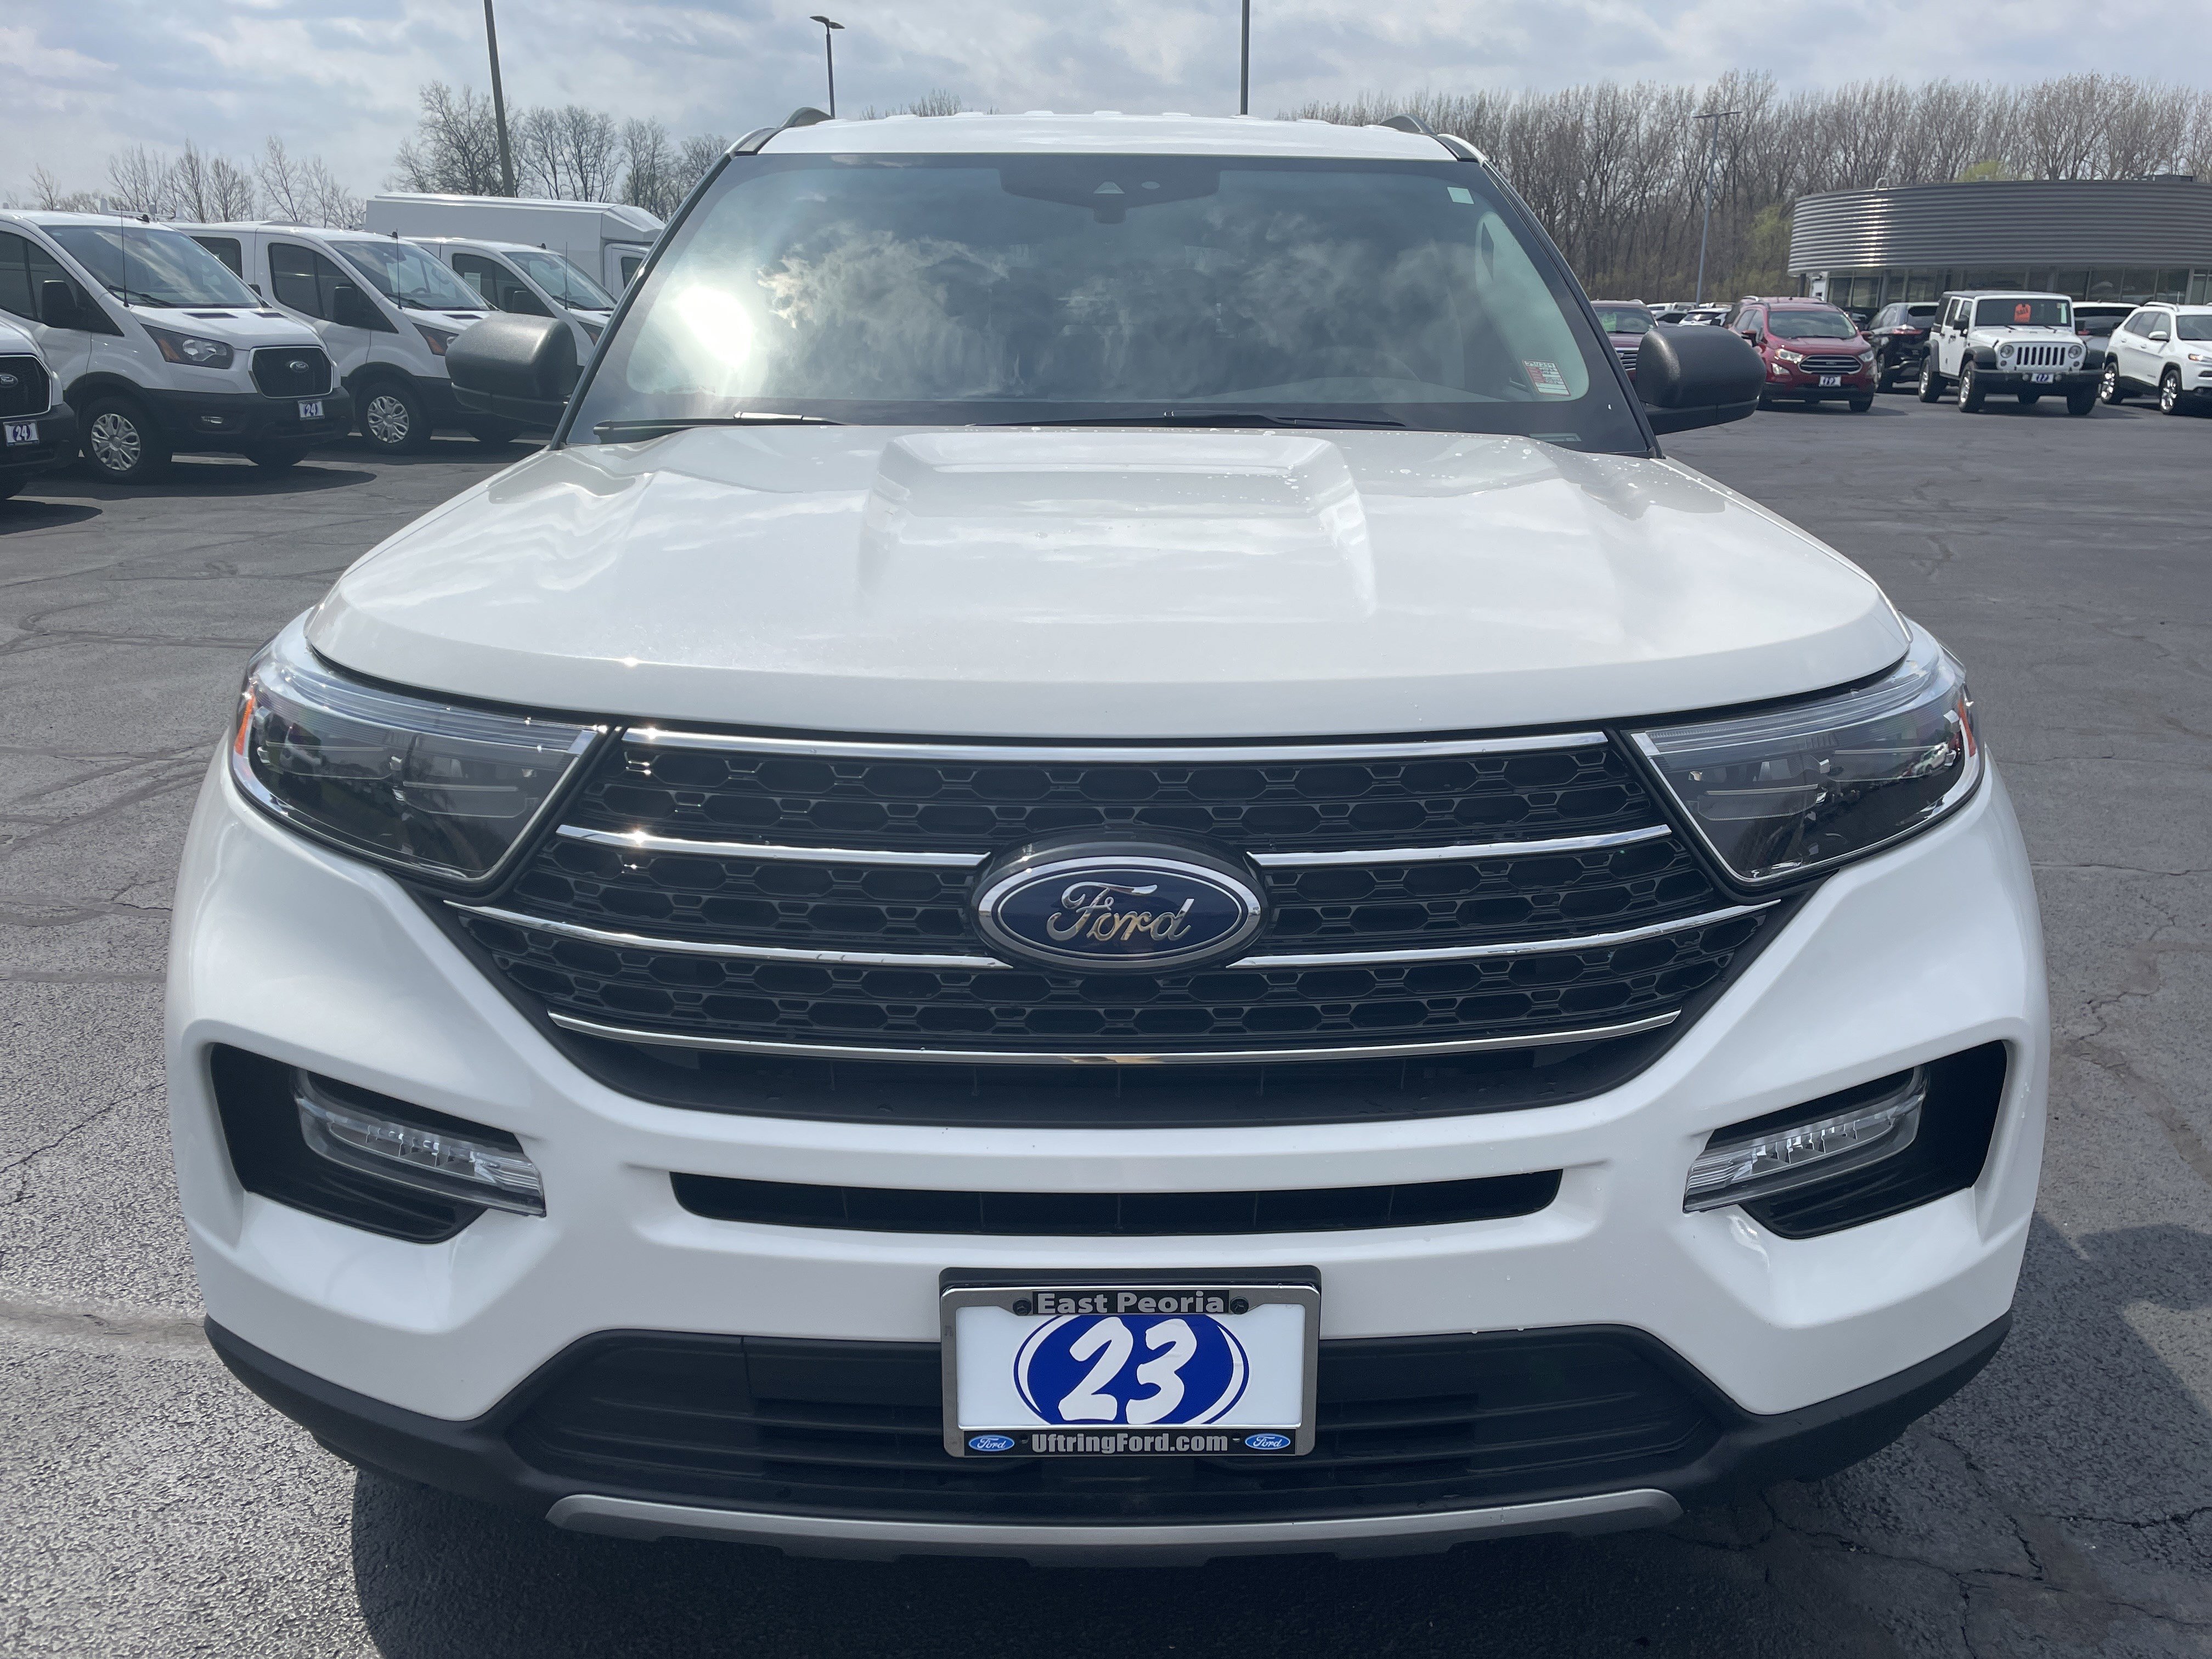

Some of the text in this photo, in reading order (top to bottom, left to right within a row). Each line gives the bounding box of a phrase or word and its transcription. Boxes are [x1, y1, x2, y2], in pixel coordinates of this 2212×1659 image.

[305, 403, 317, 416] 24
[15, 425, 28, 441] 24
[1046, 881, 1195, 941] Ford
[1037, 1290, 1225, 1314] East Peoria
[1058, 1316, 1198, 1424] 23
[977, 1436, 1007, 1450] Ford
[1032, 1432, 1228, 1454] UftringFord.com
[1252, 1435, 1283, 1449] Ford
